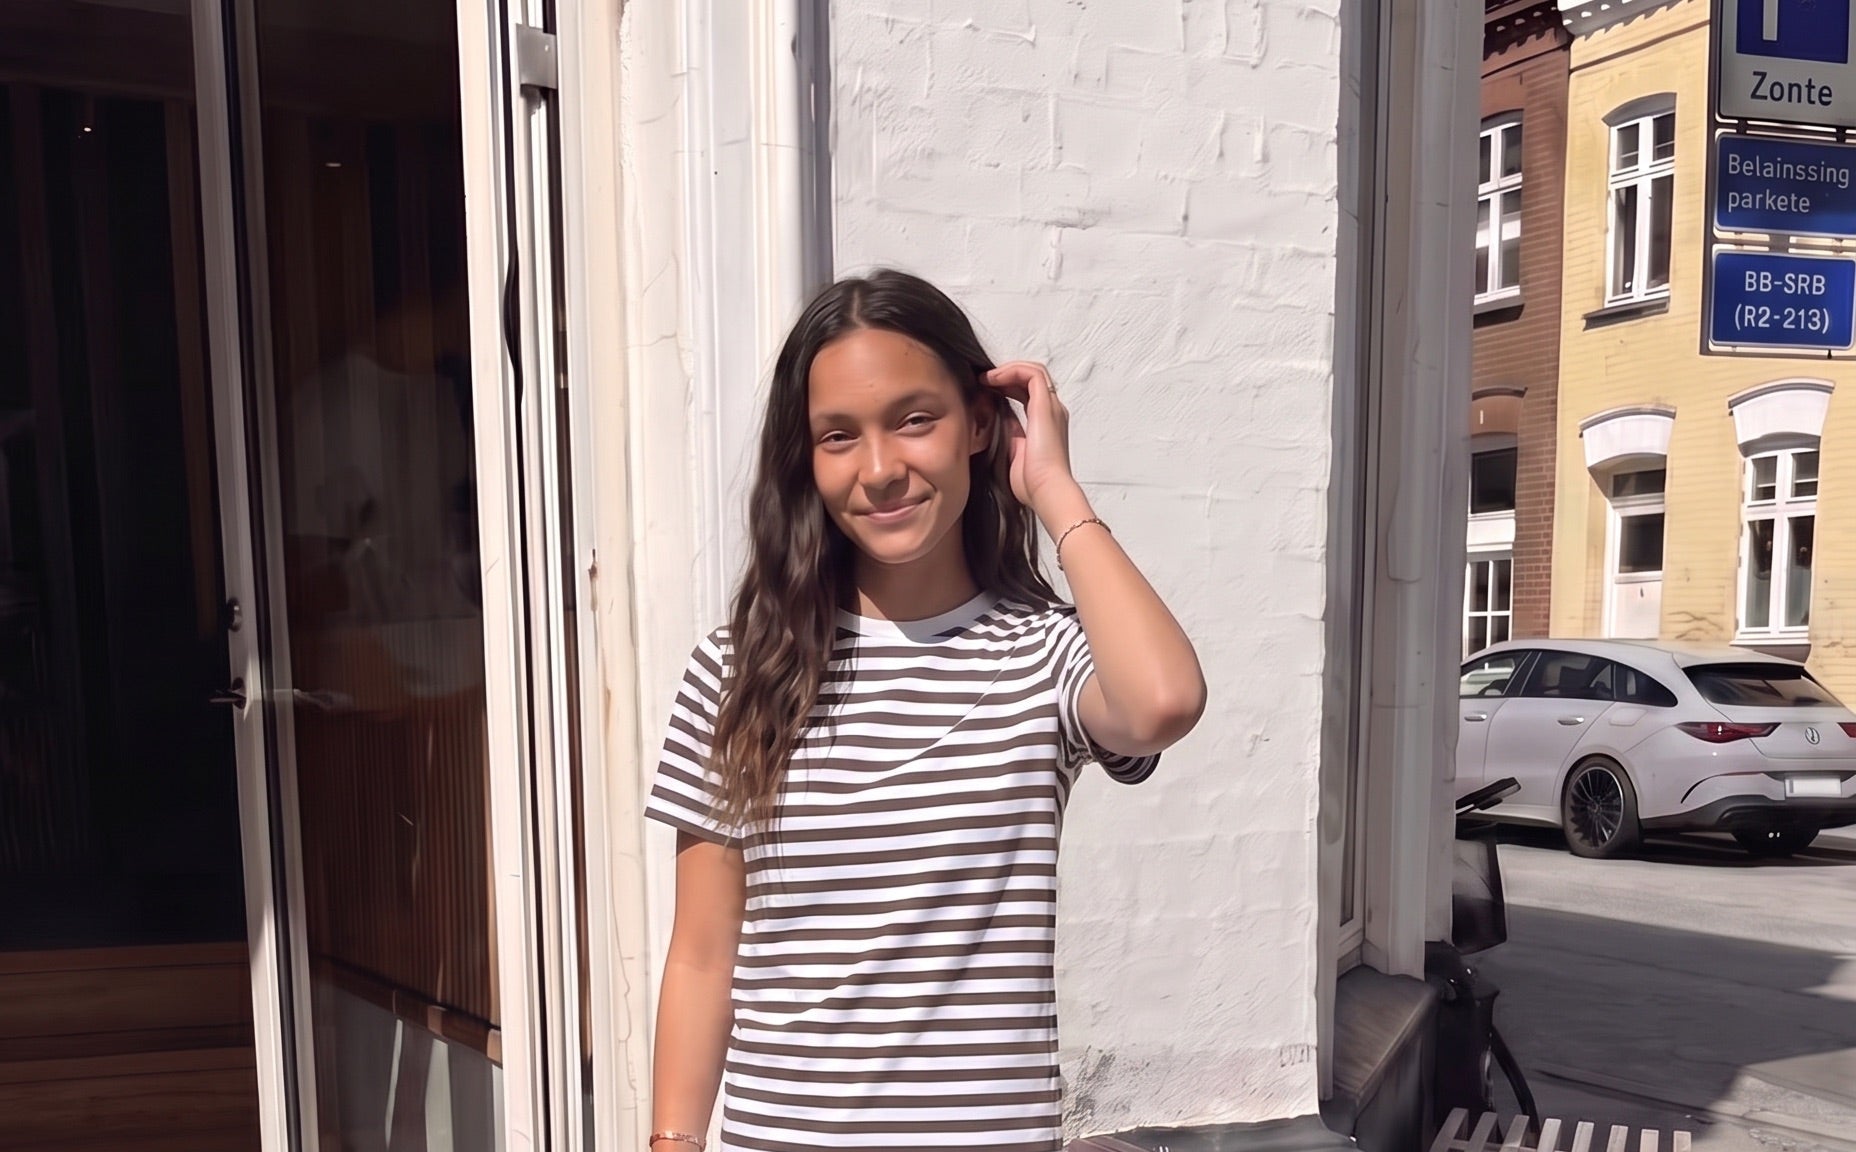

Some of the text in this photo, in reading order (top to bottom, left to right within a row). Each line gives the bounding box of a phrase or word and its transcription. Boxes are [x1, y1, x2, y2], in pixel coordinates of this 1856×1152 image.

[1750, 71, 1833, 106] Zonte
[1728, 153, 1850, 189] Belainssing
[1728, 190, 1811, 213] parkete
[1745, 271, 1826, 295] BB-SRB
[1734, 303, 1830, 334] (R2-213)
